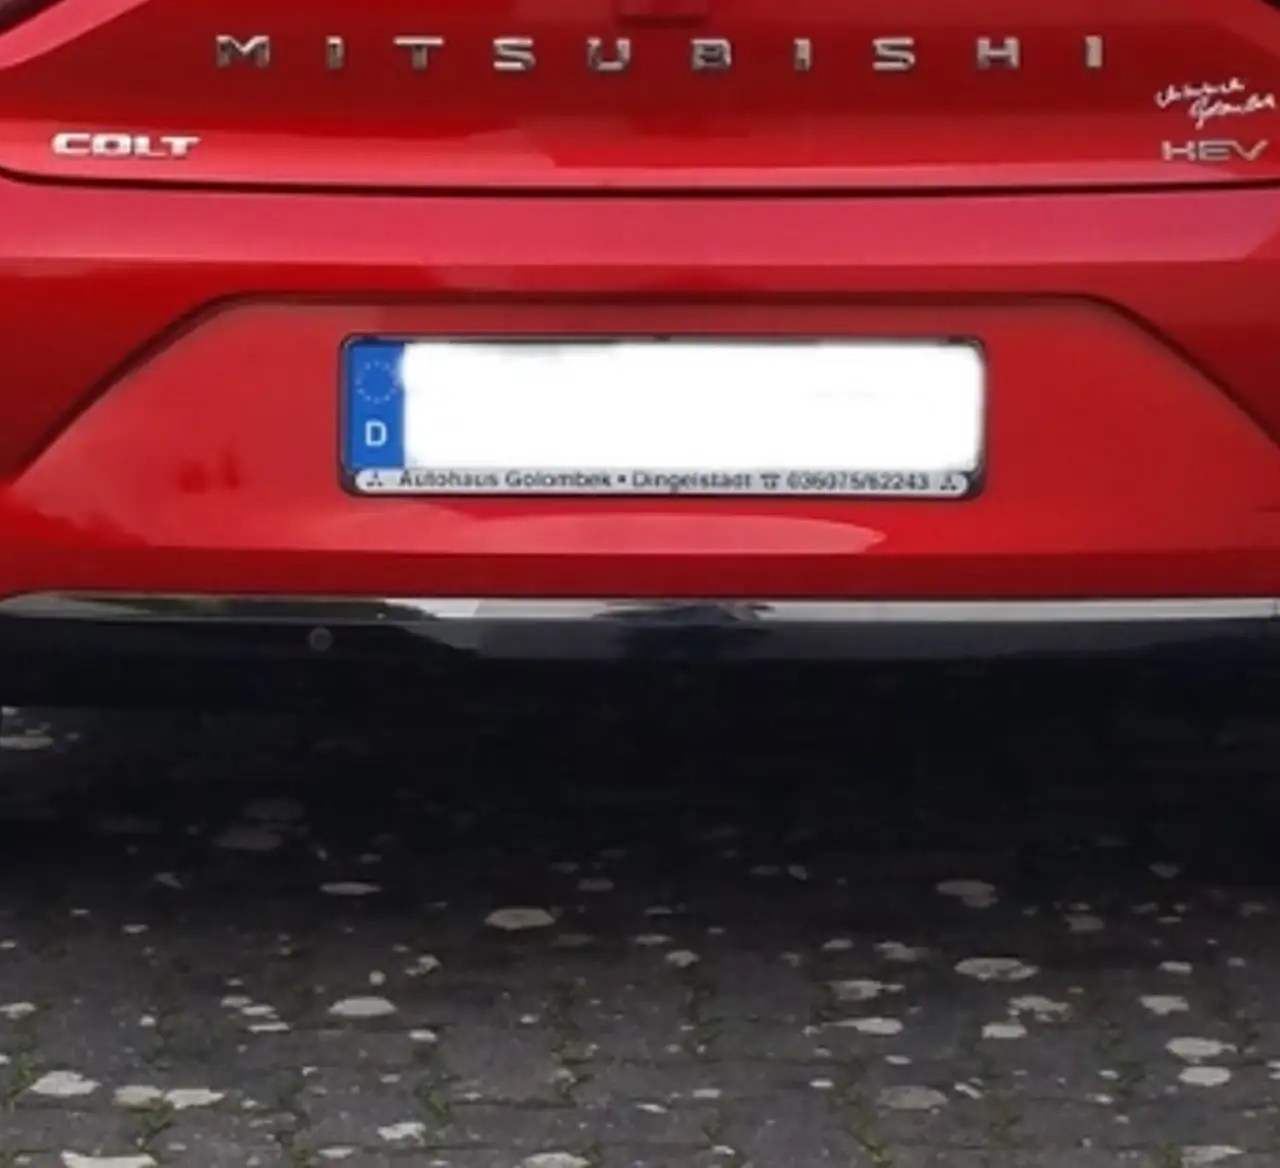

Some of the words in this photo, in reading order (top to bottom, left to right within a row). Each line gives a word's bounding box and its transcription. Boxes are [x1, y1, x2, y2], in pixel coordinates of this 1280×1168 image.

[216, 34, 1104, 72] MITSUBISHI
[52, 133, 201, 158] COLT
[1161, 139, 1269, 162] HEV
[365, 420, 387, 447] D
[398, 470, 499, 488] Autohaus
[504, 470, 612, 488] Golombek
